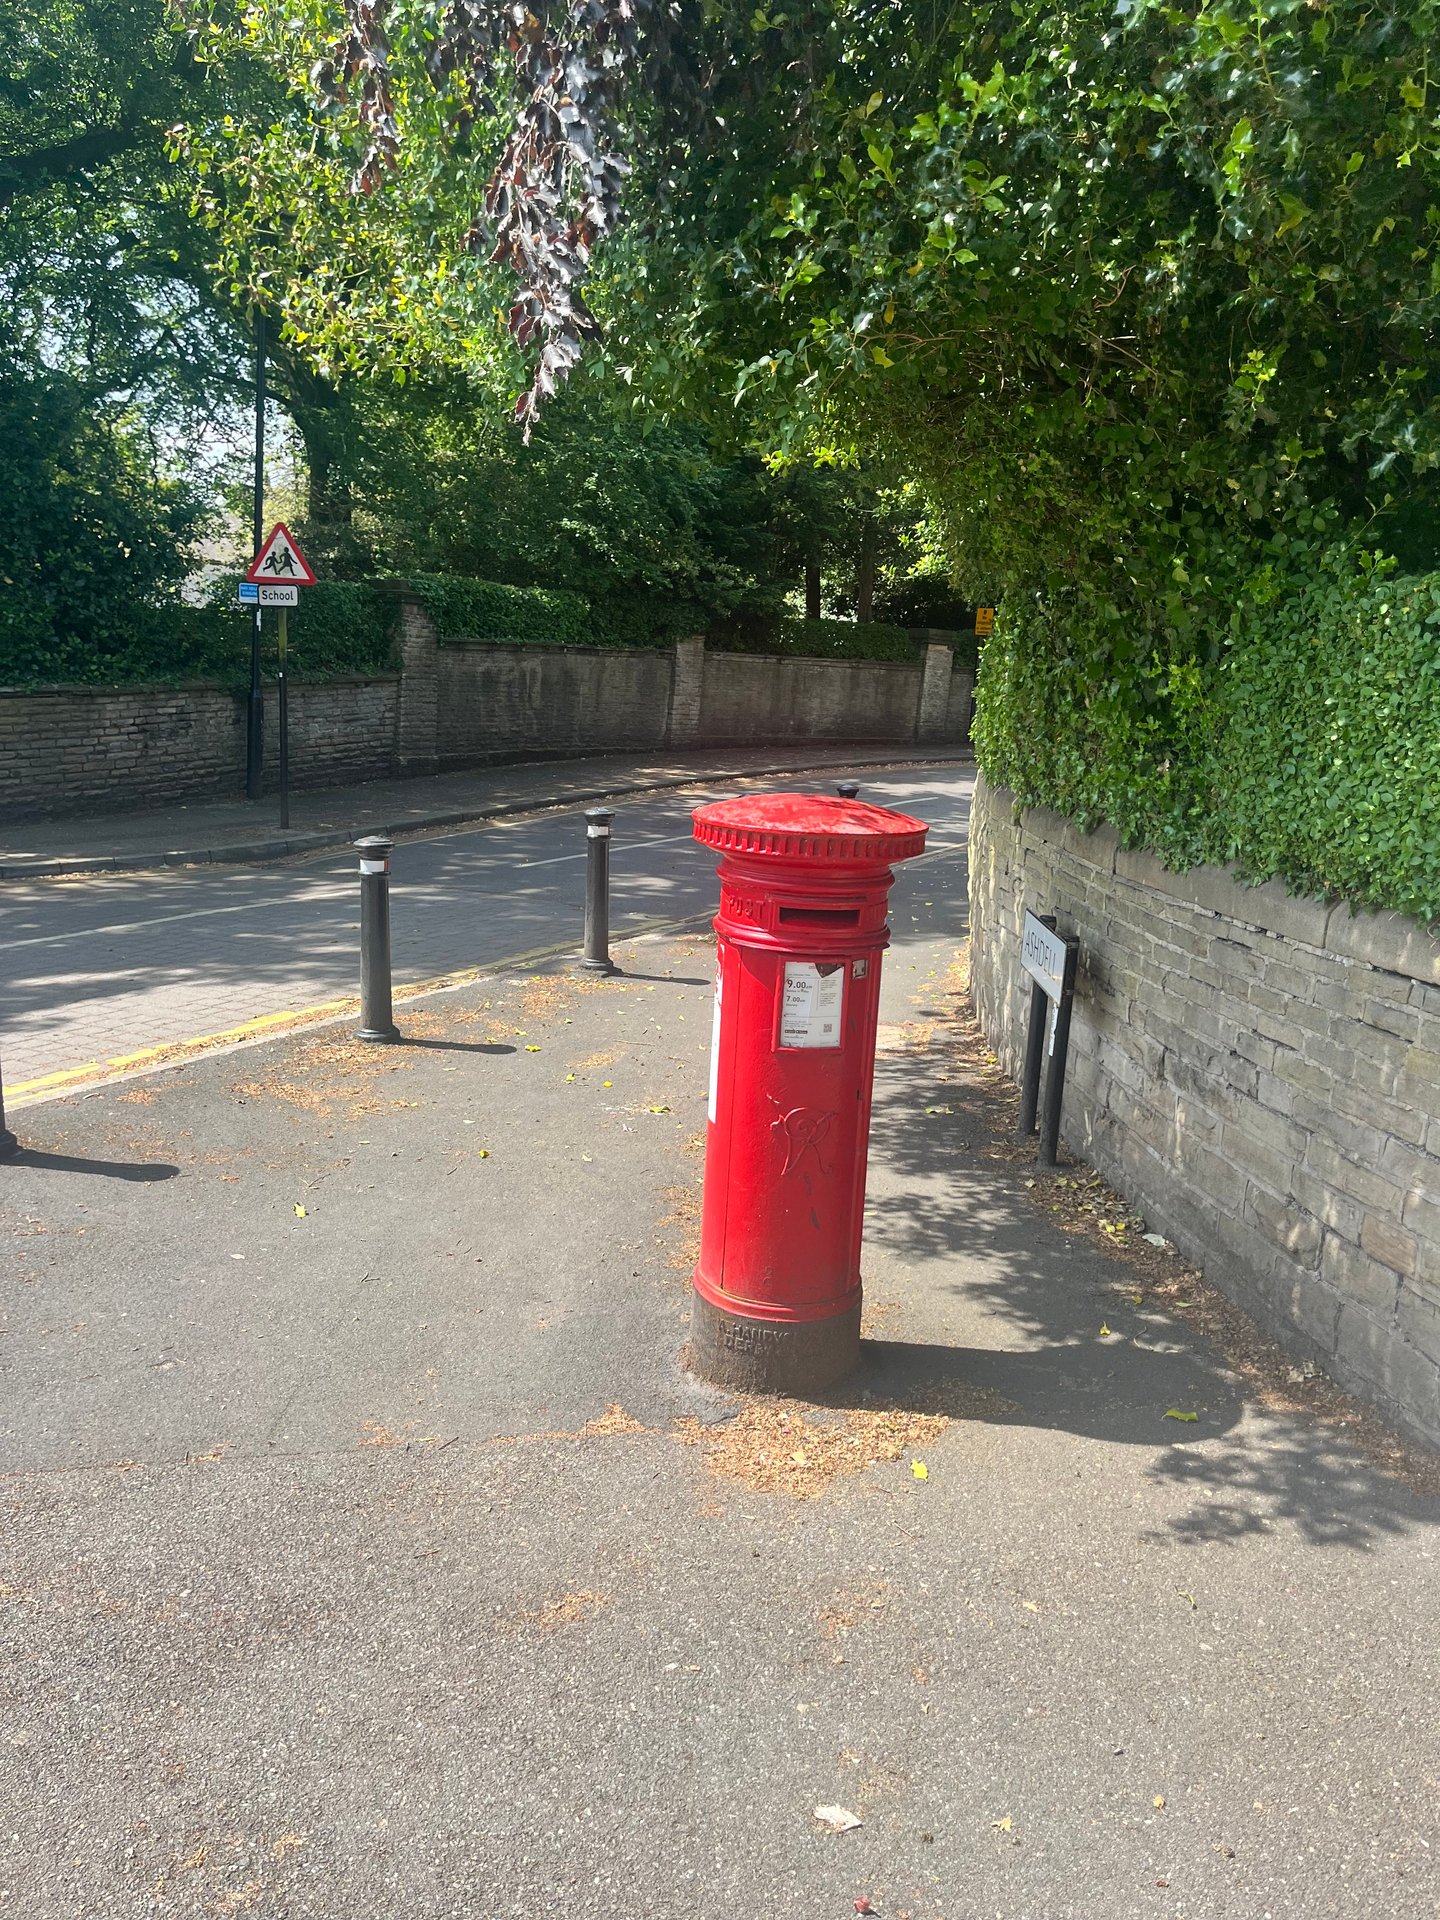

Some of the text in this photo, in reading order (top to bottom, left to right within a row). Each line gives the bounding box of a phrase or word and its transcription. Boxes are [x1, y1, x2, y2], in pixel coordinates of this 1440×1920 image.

[261, 590, 294, 601] School
[729, 895, 765, 919] POST
[1025, 929, 1057, 982] ASHDELL
